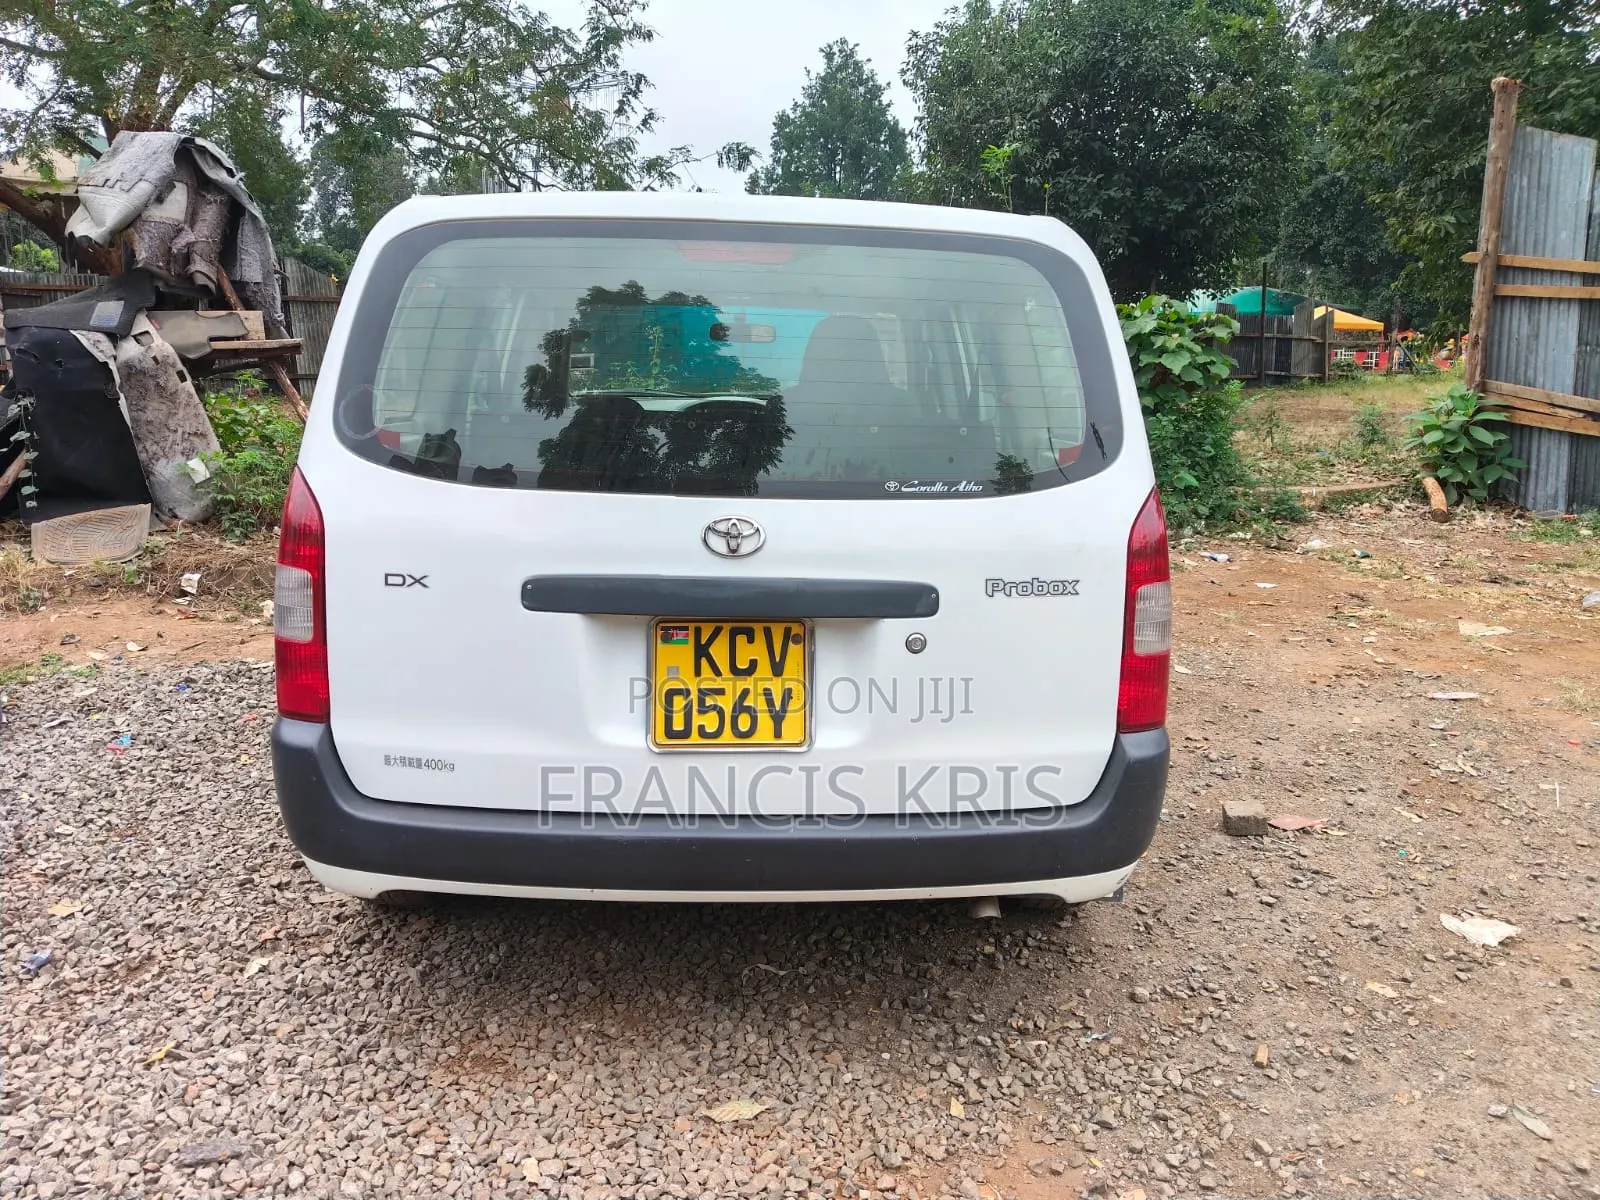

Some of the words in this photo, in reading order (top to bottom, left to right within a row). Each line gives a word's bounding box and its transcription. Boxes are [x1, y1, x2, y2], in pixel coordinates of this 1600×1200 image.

[900, 480, 949, 493] Corolla
[384, 573, 430, 589] DX
[985, 577, 1080, 597] Probox
[693, 626, 793, 677] KCV
[664, 687, 793, 739] 056Y
